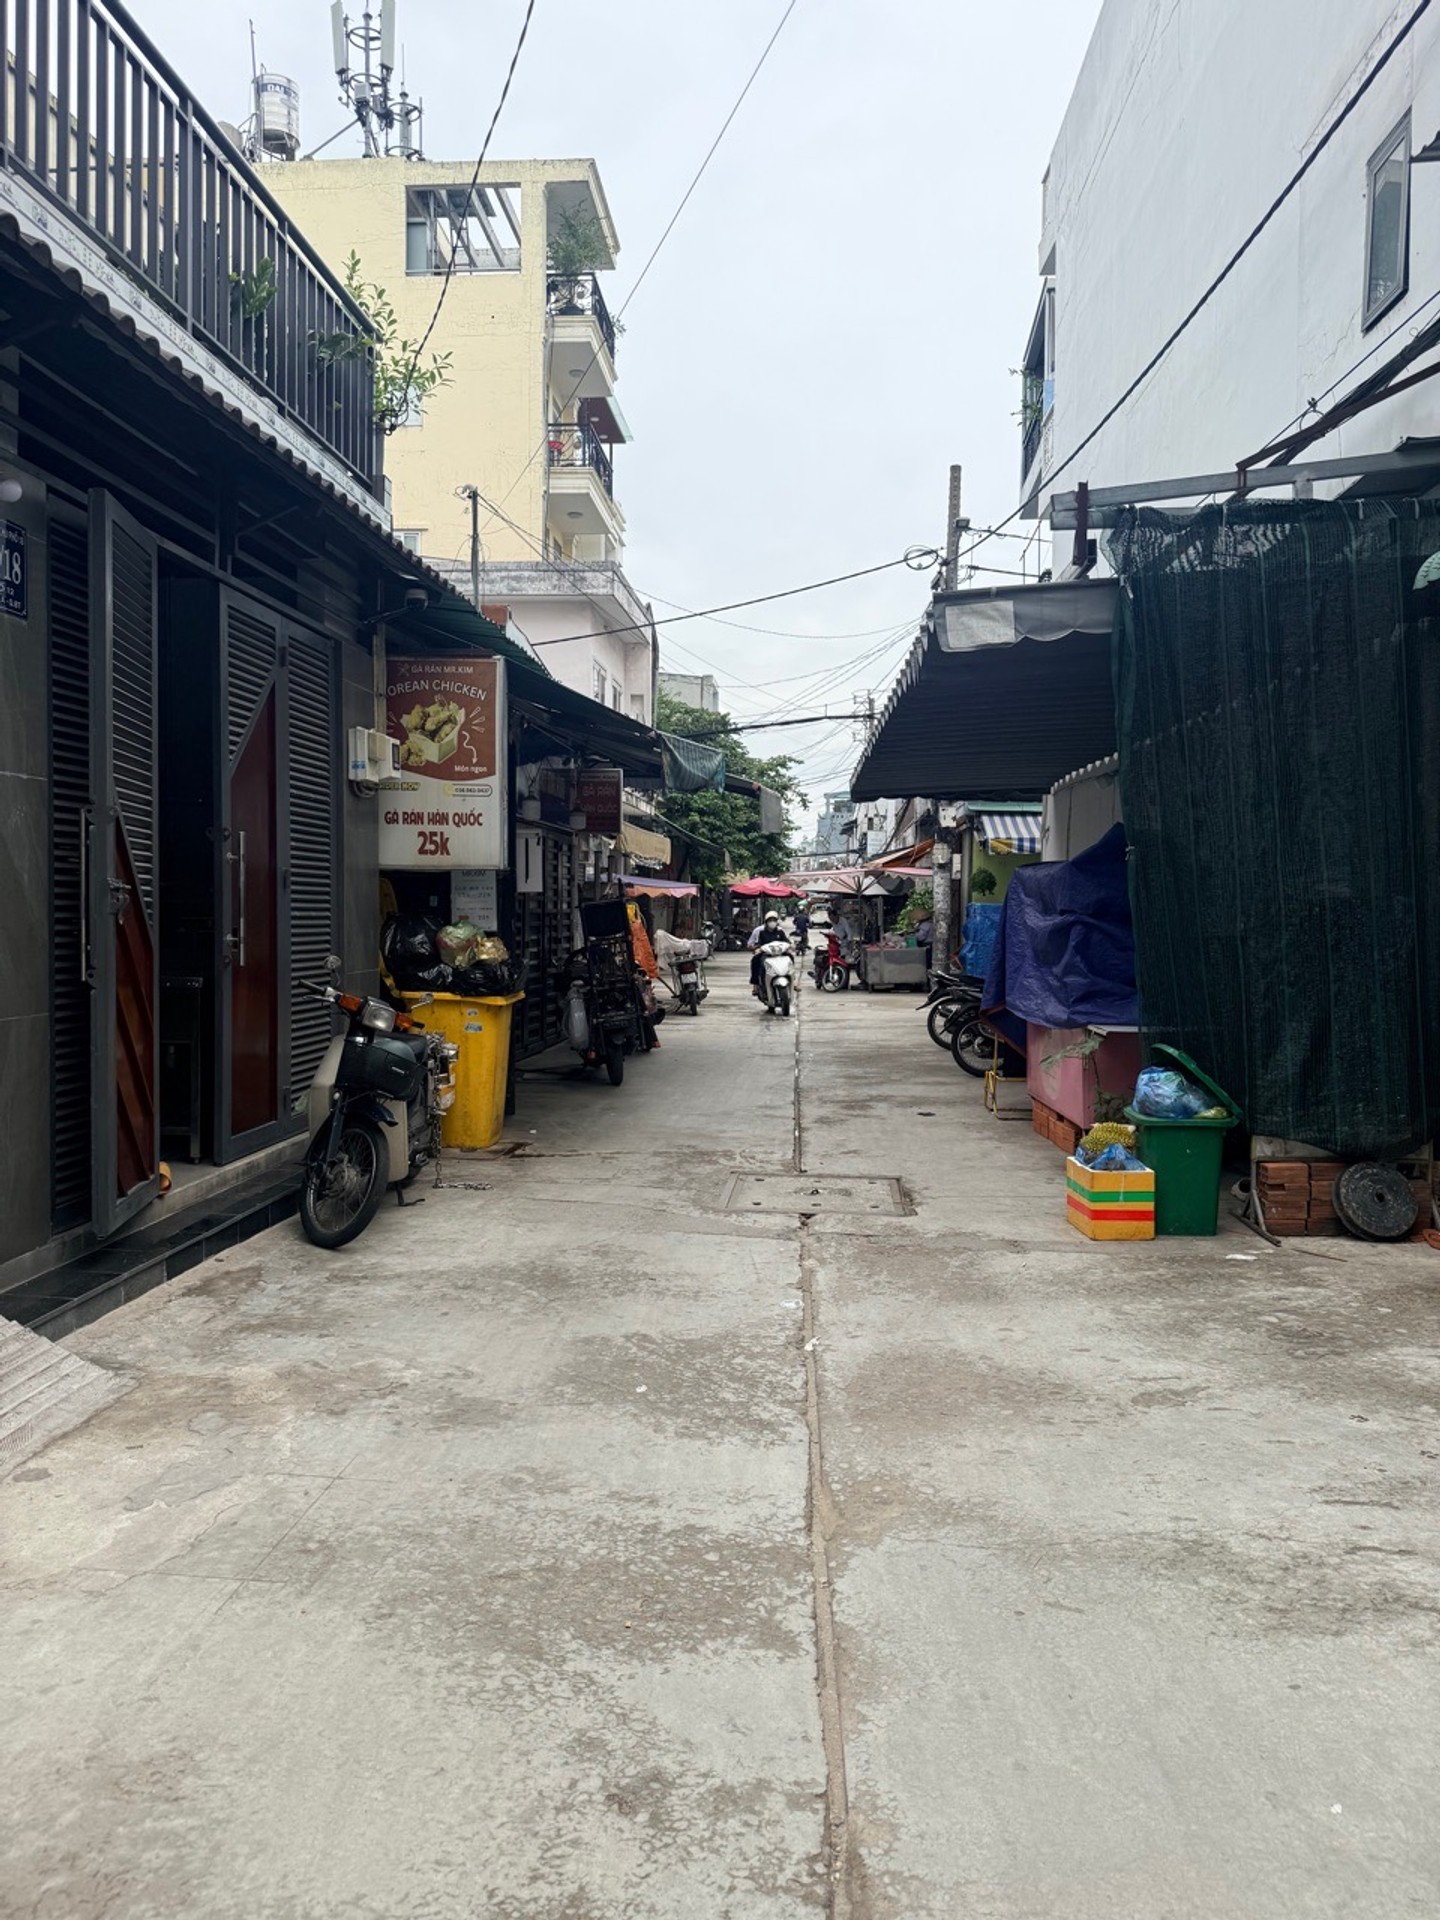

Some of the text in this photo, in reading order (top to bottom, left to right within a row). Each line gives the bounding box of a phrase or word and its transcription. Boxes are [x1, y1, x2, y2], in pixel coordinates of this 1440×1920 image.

[387, 680, 487, 701] OREAN CHICKEN
[470, 766, 488, 774] ngon
[384, 807, 484, 828] GÀ RÁN HÀN QUỐC
[417, 831, 451, 856] 25k
